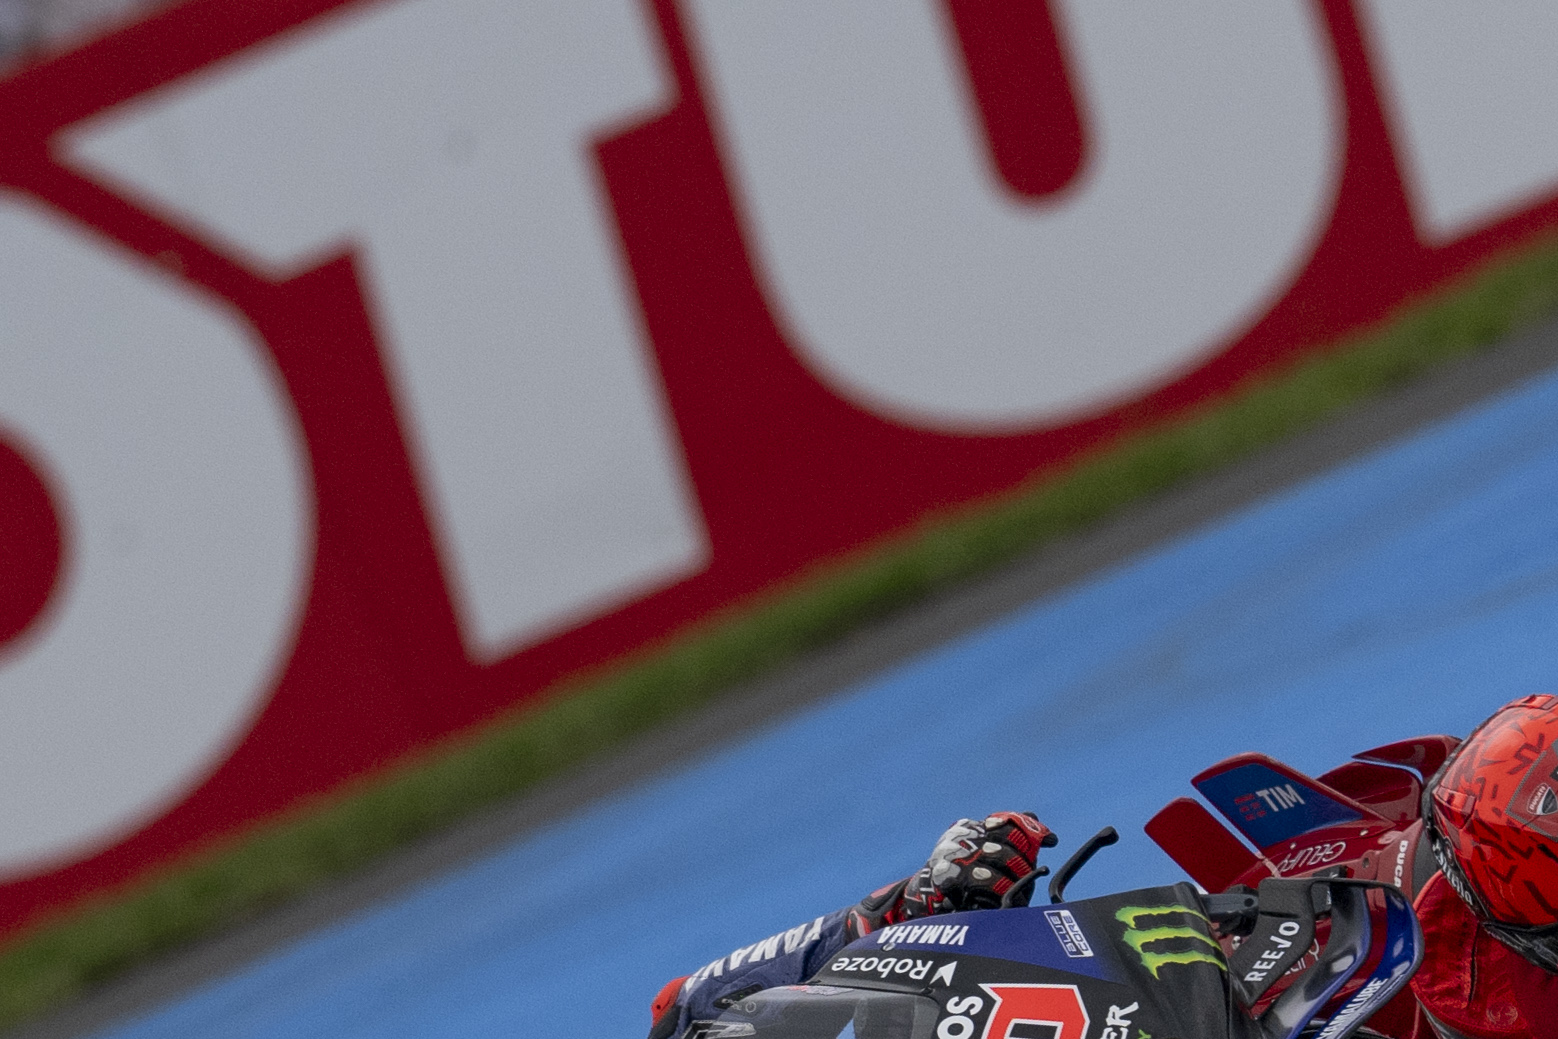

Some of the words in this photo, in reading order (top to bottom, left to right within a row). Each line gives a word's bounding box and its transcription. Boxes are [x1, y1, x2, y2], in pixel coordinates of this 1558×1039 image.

[1256, 783, 1306, 812] TIM
[1393, 840, 1410, 889] DUCA
[876, 925, 970, 946] YAMAHA
[1244, 921, 1301, 982] REEVO
[831, 957, 935, 981] Roboze
